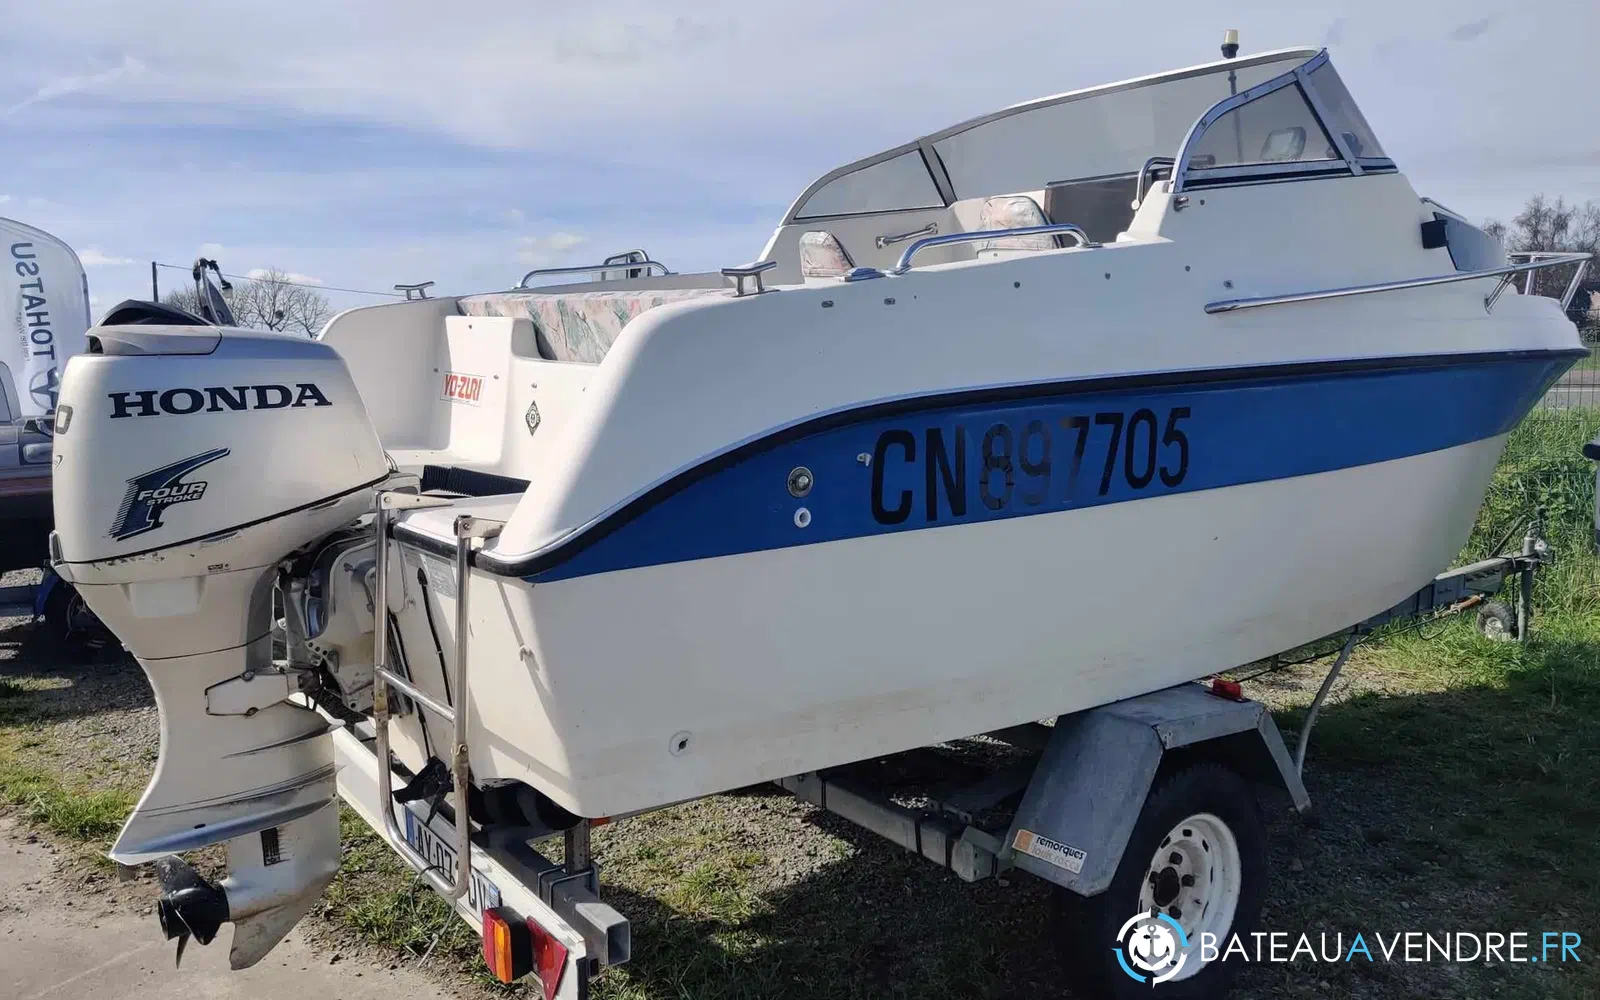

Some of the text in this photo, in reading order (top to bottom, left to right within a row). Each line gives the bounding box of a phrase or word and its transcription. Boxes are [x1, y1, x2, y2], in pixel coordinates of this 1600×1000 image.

[444, 374, 482, 401] YO-ZURI
[108, 383, 333, 418] HONDA
[870, 406, 1191, 525] CN897705
[138, 482, 206, 501] FOUR
[146, 493, 202, 506] STROKE
[1036, 836, 1084, 860] remorques
